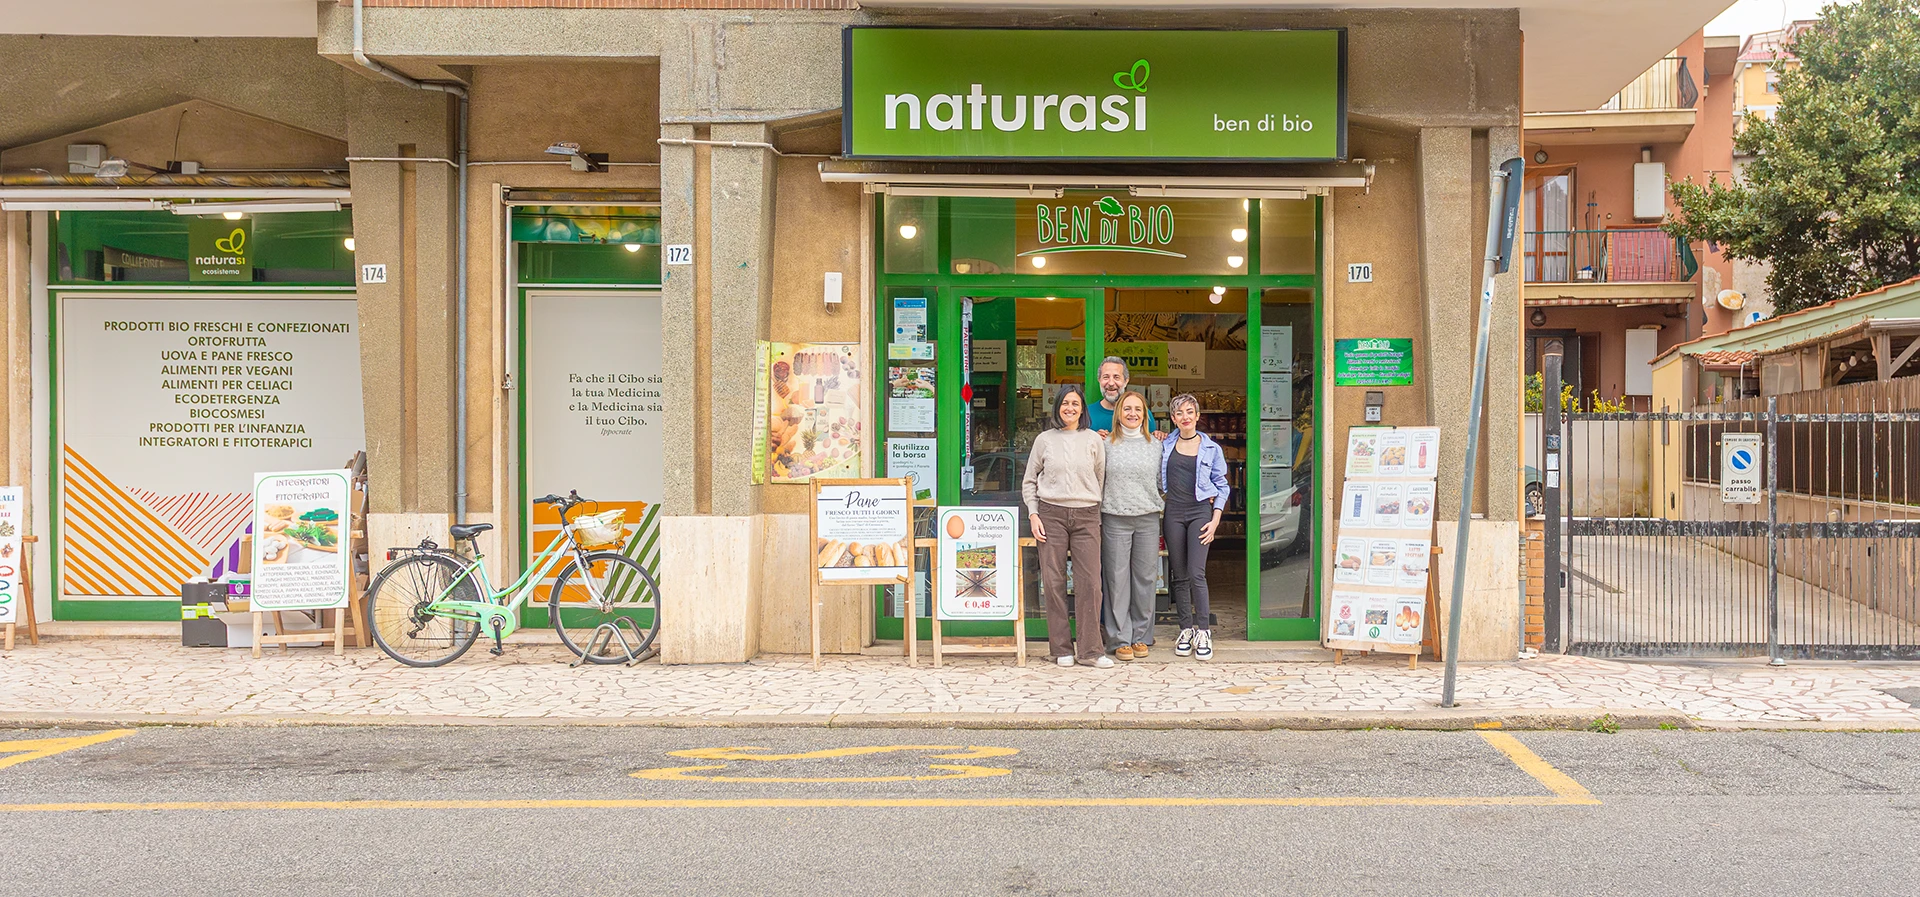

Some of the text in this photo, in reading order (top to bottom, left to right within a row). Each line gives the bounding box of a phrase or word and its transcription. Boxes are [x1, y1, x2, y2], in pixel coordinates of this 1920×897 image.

[1213, 113, 1313, 133] ben di bio
[1037, 203, 1175, 245] BEN DI BIO
[669, 247, 690, 262] 172
[364, 267, 385, 281] 174
[1350, 266, 1370, 280] 170
[104, 321, 350, 334] PRODOTTI BIO FRESCHI E CONFEZIONATI
[188, 336, 266, 347] ORTOFRUTTA
[161, 350, 293, 362] UOVA E PANE FRESCO
[161, 365, 293, 376] ALIMENTI PER VEGANI
[569, 374, 662, 384] Fa che il Cibo sia
[161, 380, 292, 390] ALIMENTI PER CELIACI
[572, 388, 661, 398] la tua Medicina
[174, 394, 280, 405] ECODETERGENZA
[578, 402, 588, 412] la
[592, 402, 644, 412] Medicina
[647, 402, 662, 412] sia
[190, 408, 265, 420] BIOCOSMESI
[585, 416, 648, 426] il tuo Cibo.
[150, 423, 210, 434] PRODOTTI
[214, 423, 234, 434] PER
[139, 436, 312, 448] INTEGRATORI E FITOTERAPICI
[276, 478, 330, 486] INTEGRATORI
[276, 492, 330, 501] FITOTERAPICI
[845, 490, 880, 509] Pane
[976, 514, 1005, 522] UOVA
[978, 532, 1003, 540] biologico
